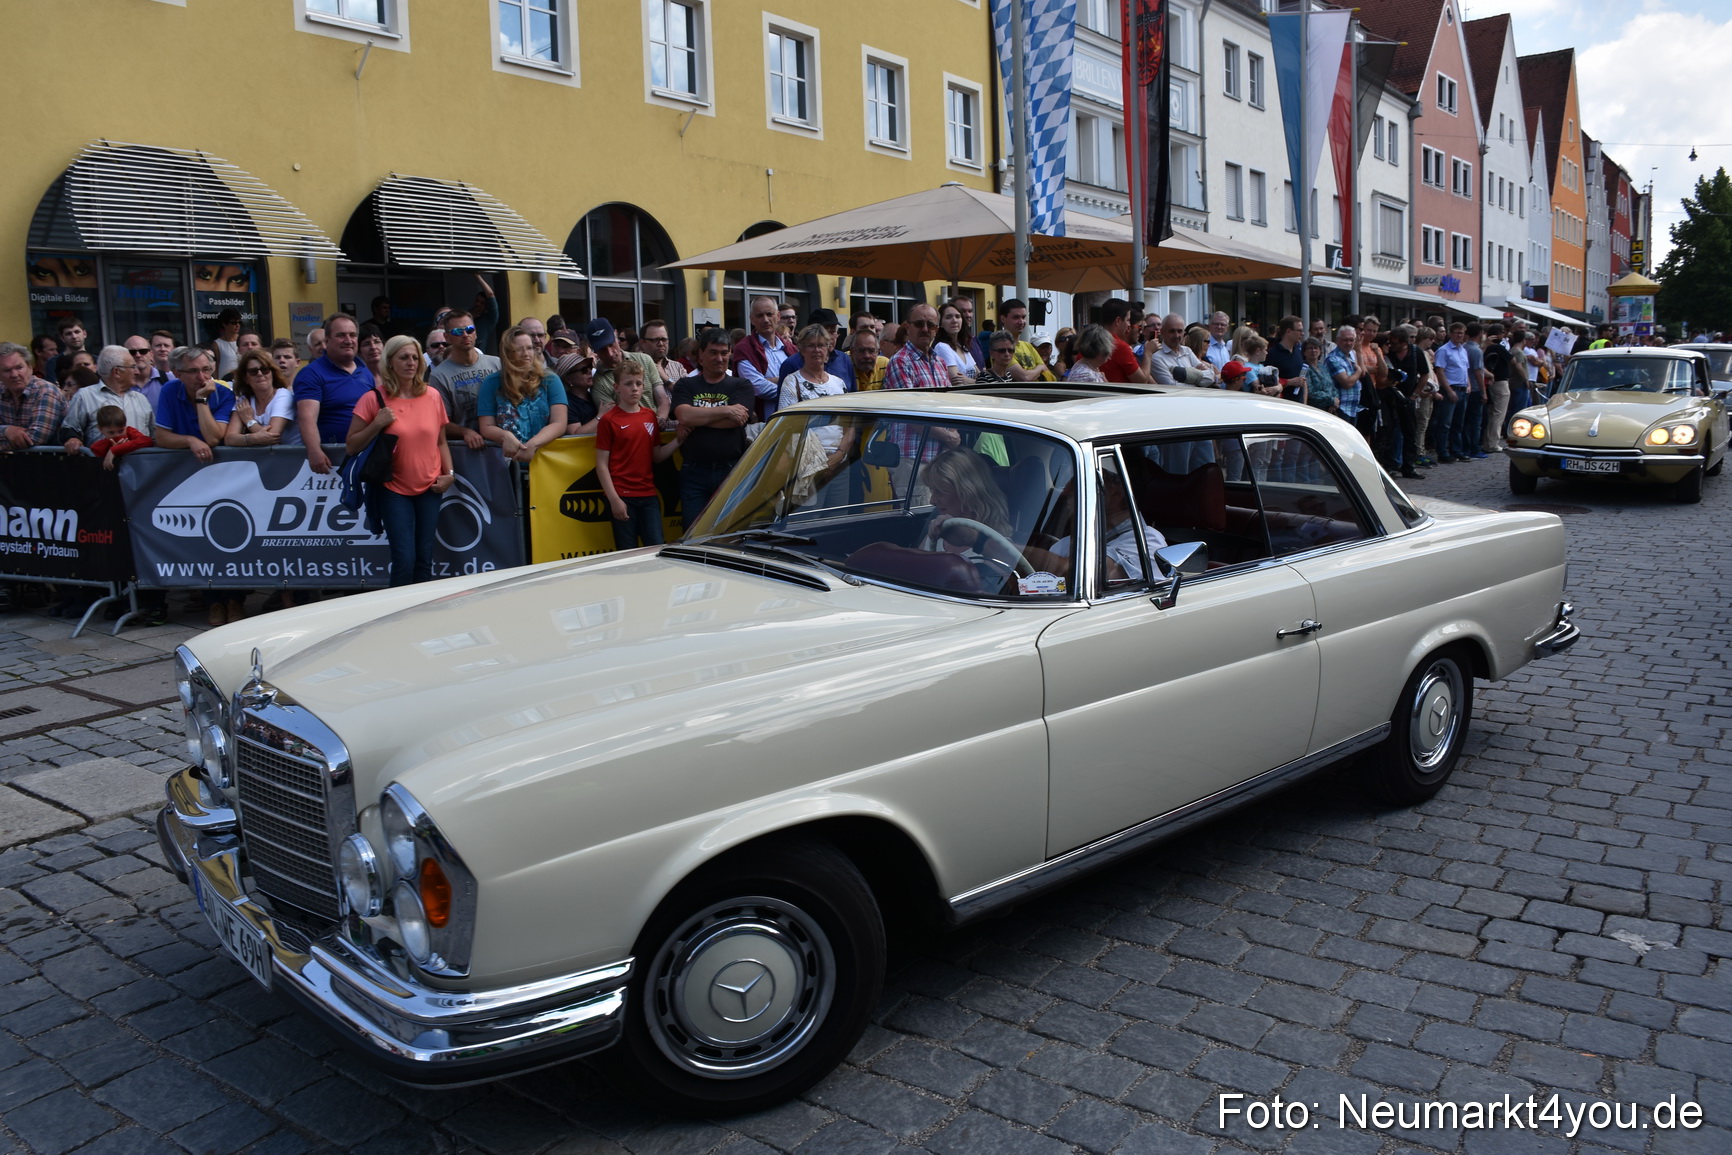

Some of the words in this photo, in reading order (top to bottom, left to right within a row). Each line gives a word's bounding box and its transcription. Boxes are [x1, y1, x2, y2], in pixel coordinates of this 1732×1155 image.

[30, 293, 63, 303] Digitale
[64, 294, 89, 302] Bilder
[208, 298, 245, 306] Passbilder
[986, 301, 994, 310] 24
[451, 371, 477, 383] UNCLE
[1566, 459, 1579, 470] RH
[77, 529, 113, 544] GmbH
[261, 538, 344, 547] BREITENBRUNN
[37, 542, 79, 559] Pyrbaum
